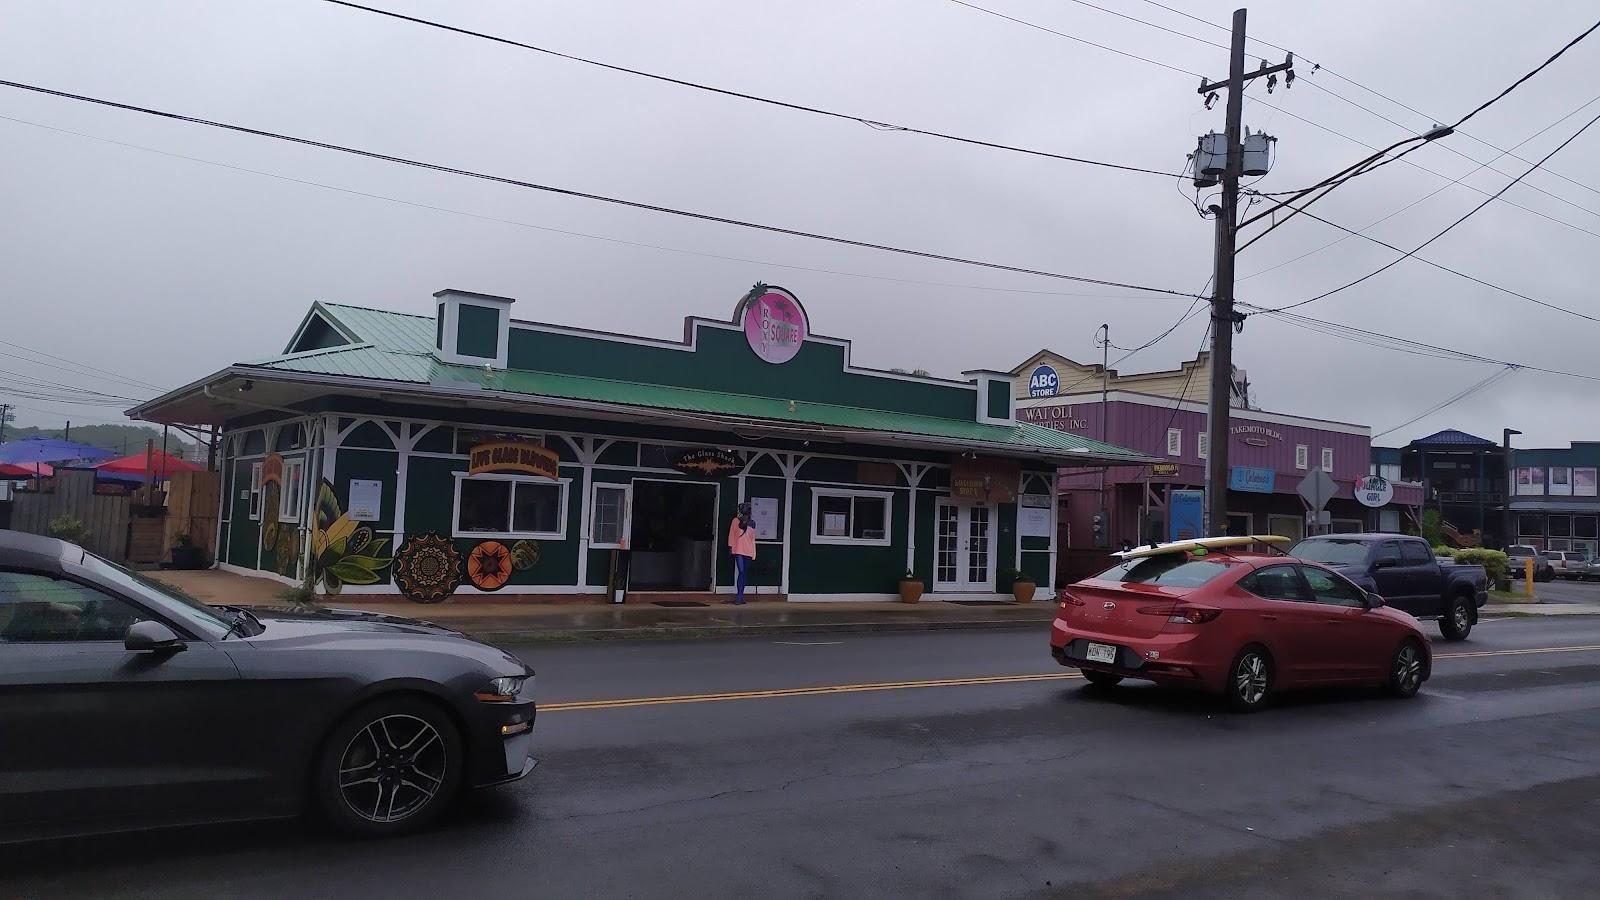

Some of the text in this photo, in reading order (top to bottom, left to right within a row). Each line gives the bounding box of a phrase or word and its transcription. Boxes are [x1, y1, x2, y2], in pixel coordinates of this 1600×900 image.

[770, 325, 798, 343] SQUARE
[1030, 373, 1057, 388] ABC
[1032, 388, 1054, 397] STORE
[1070, 419, 1089, 429] INC.
[1230, 424, 1265, 435] TAKEMOTO
[471, 449, 490, 469] LIVE
[492, 446, 519, 464] GLASS
[683, 449, 735, 463] The Glass Shack
[1366, 492, 1381, 502] GIRL
